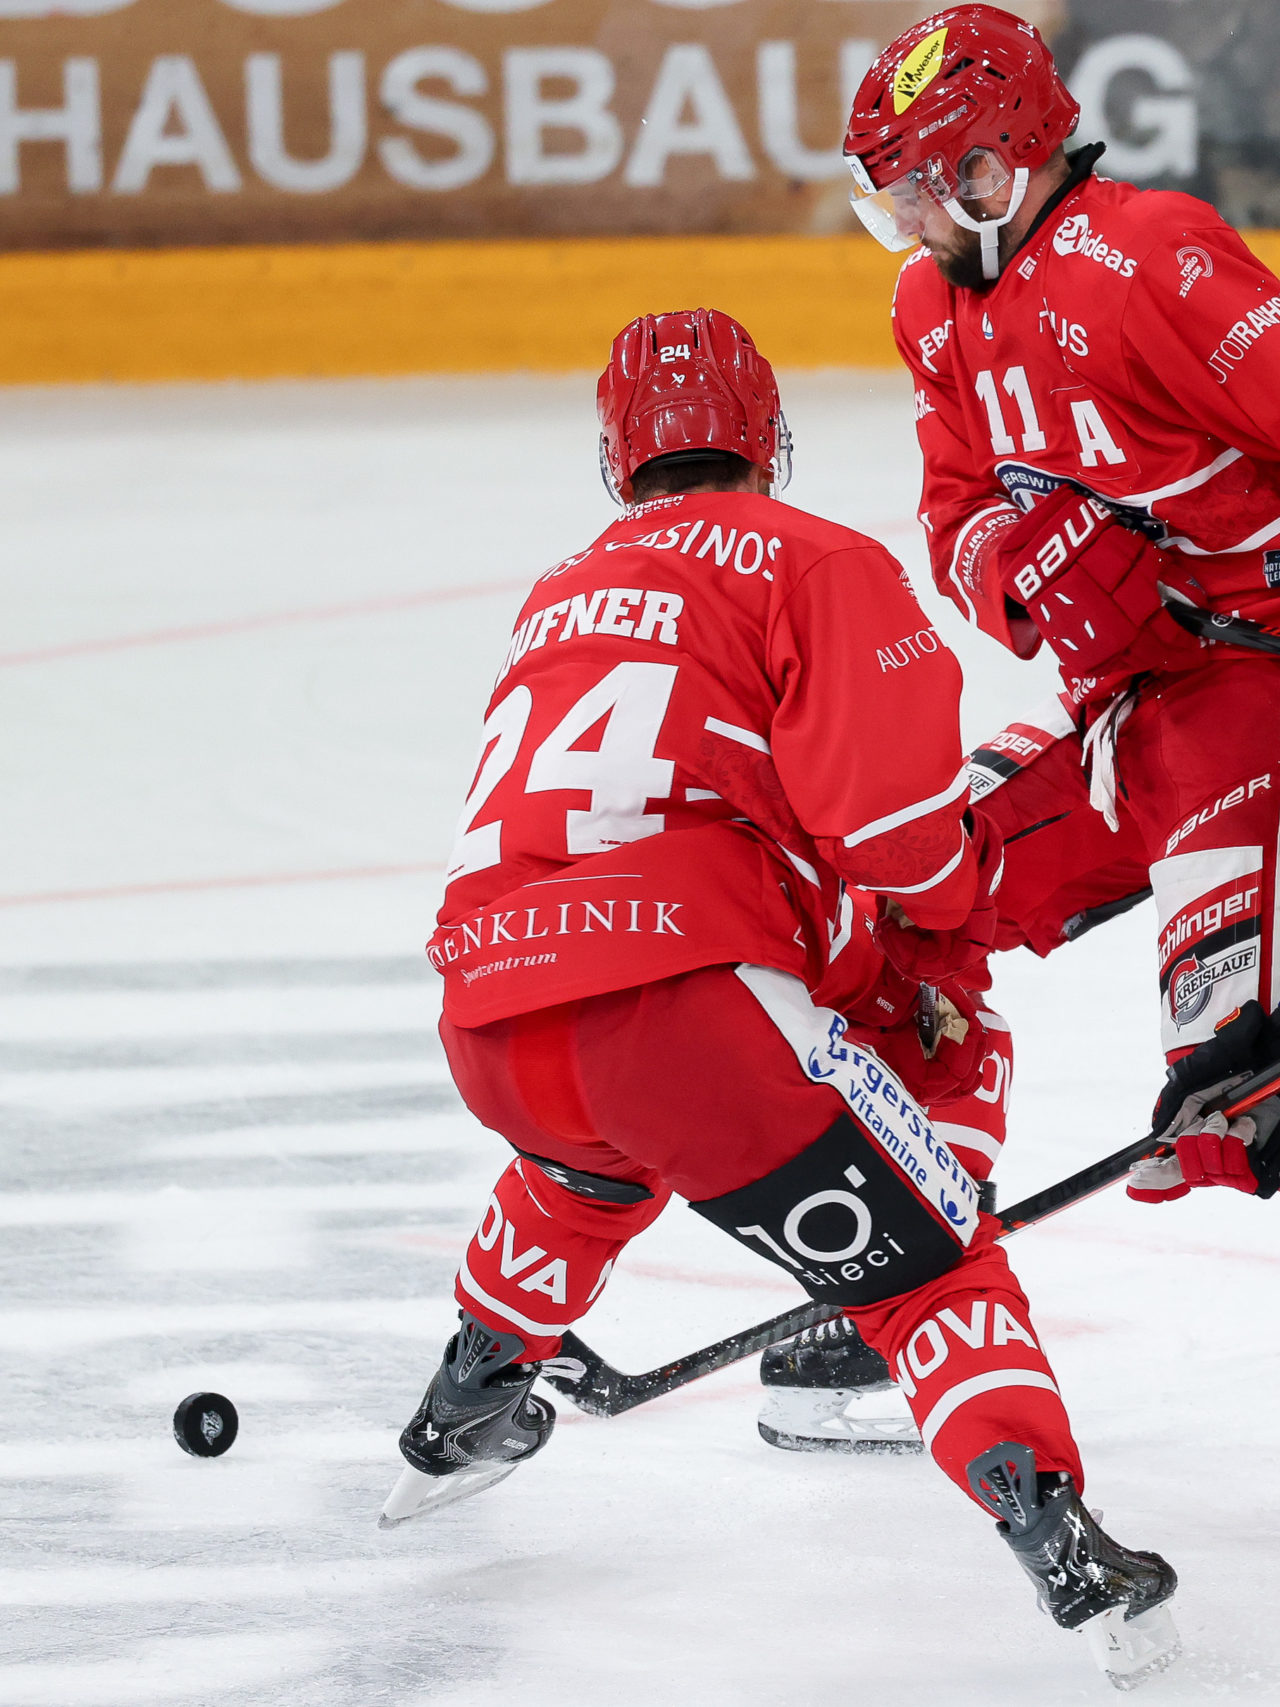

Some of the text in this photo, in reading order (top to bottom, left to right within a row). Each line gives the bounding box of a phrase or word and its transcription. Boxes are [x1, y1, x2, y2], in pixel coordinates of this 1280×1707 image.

[660, 343, 691, 363] 24
[975, 365, 1047, 456] 11
[1069, 399, 1127, 467] A
[447, 661, 680, 888] 24
[1165, 773, 1272, 858] BAUER
[1176, 951, 1254, 1003] KREISLAUF
[826, 1013, 976, 1203] Burgerstein
[848, 1078, 928, 1187] Vitamine
